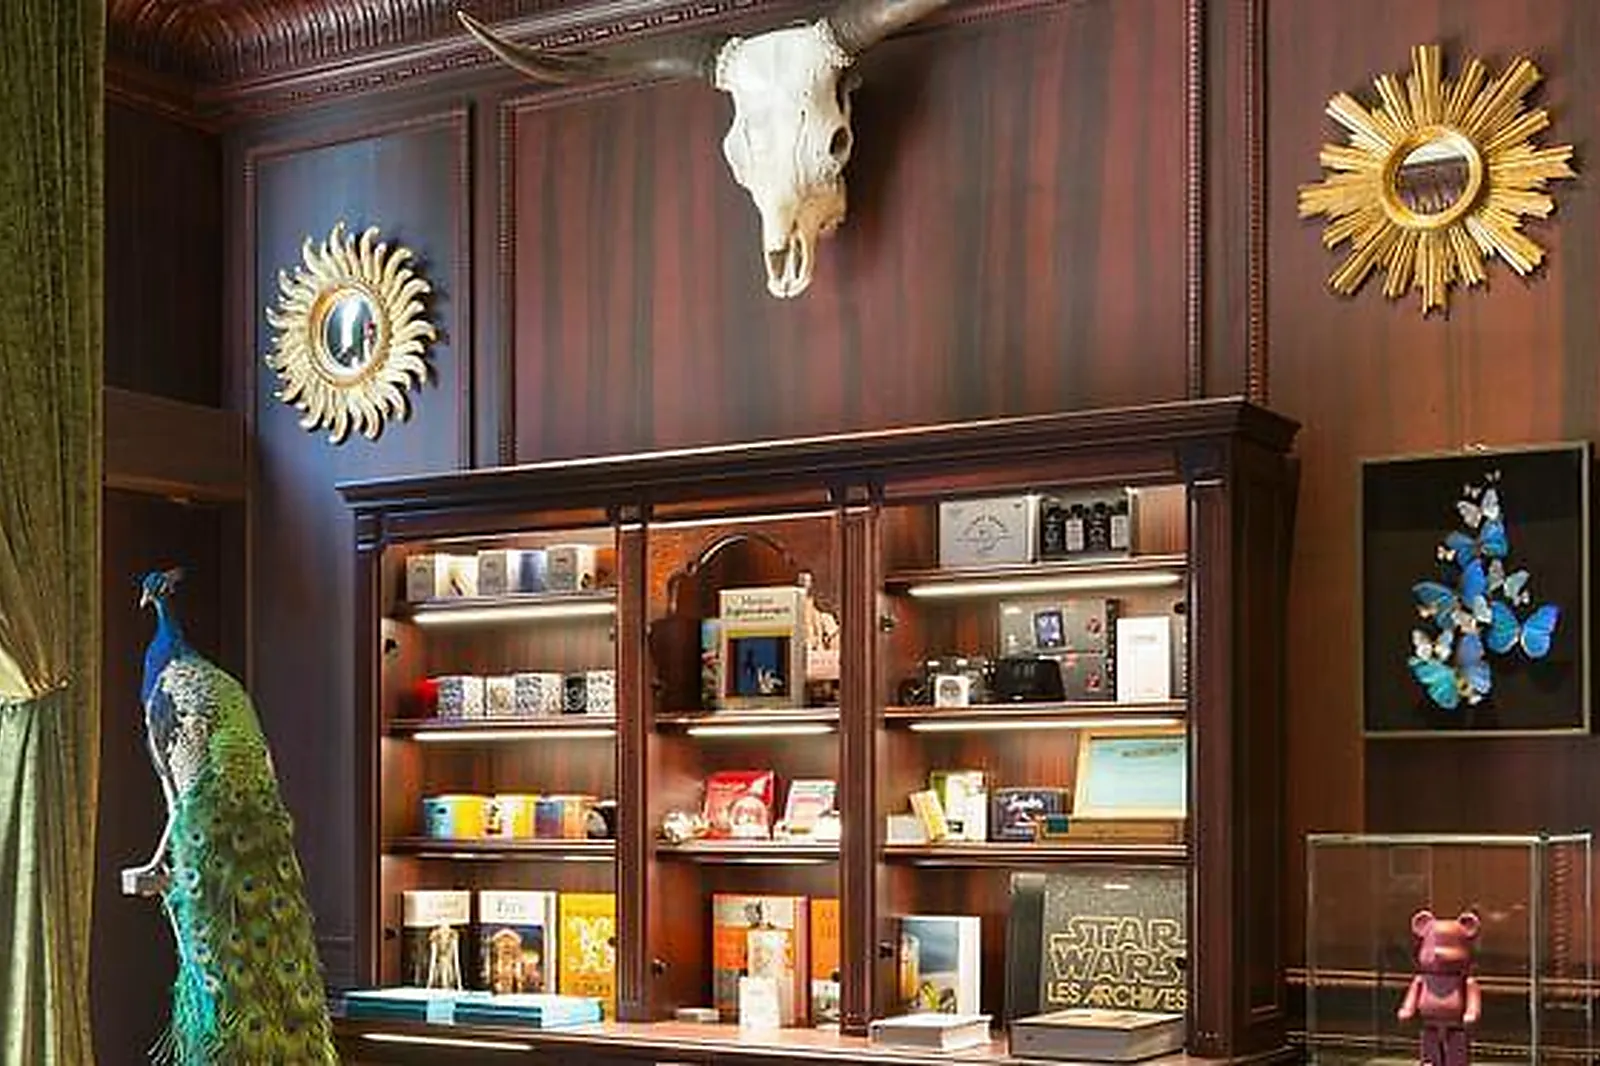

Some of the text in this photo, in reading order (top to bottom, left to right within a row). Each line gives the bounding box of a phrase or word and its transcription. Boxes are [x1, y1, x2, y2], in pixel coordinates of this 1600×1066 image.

[1051, 916, 1187, 950] STAR
[1051, 947, 1187, 985] WARS
[1047, 981, 1187, 1010] LES ARCHIVES
